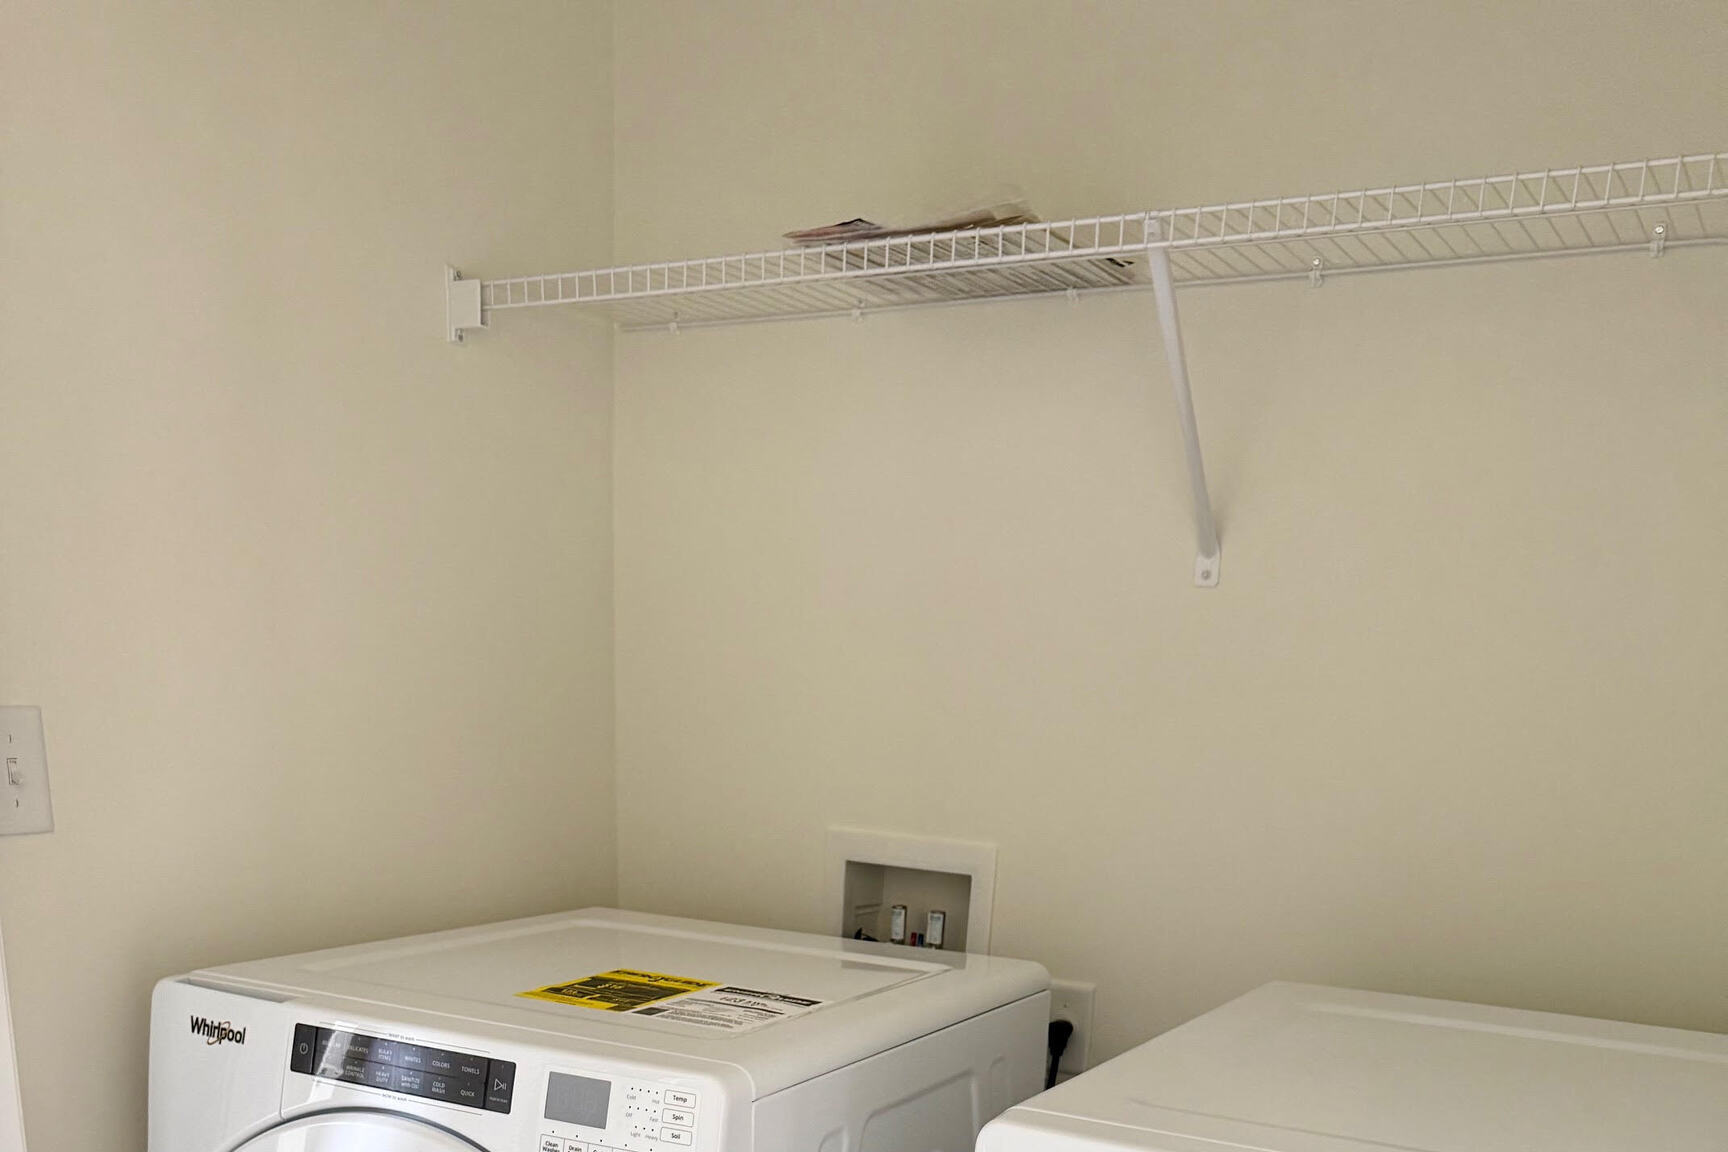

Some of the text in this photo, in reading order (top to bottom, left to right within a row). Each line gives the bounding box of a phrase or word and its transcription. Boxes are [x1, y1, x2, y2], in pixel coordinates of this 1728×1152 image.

[190, 1015, 246, 1045] Whirlpool
[432, 1060, 450, 1069] COLORS
[461, 1066, 480, 1075] TOWELS
[460, 1089, 475, 1098] QUICK
[673, 1095, 688, 1104] Temp
[672, 1113, 684, 1121] Spin
[671, 1132, 681, 1140] Soil
